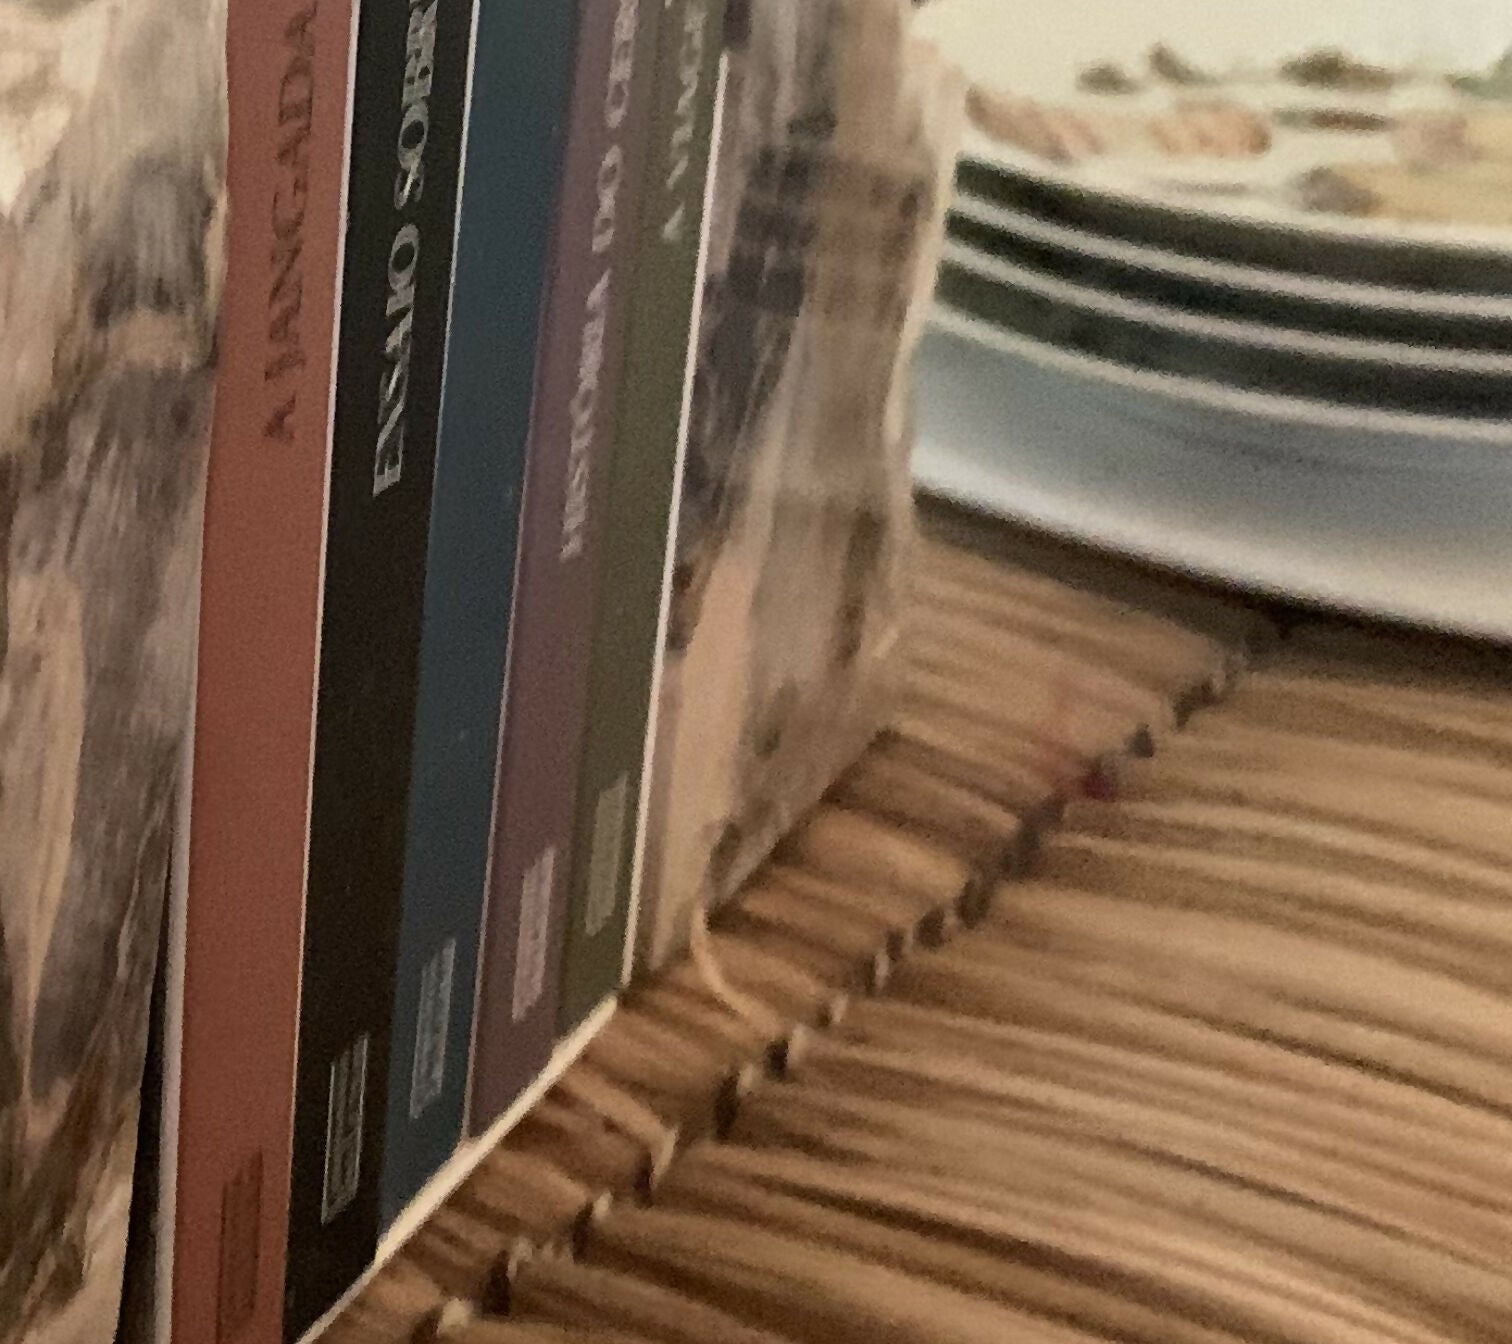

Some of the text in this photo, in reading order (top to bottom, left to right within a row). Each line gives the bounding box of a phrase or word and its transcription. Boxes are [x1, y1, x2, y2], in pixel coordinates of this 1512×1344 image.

[264, 2, 318, 383] JANGADA
[264, 396, 295, 440] A
[372, 222, 422, 499] ENSAIO
